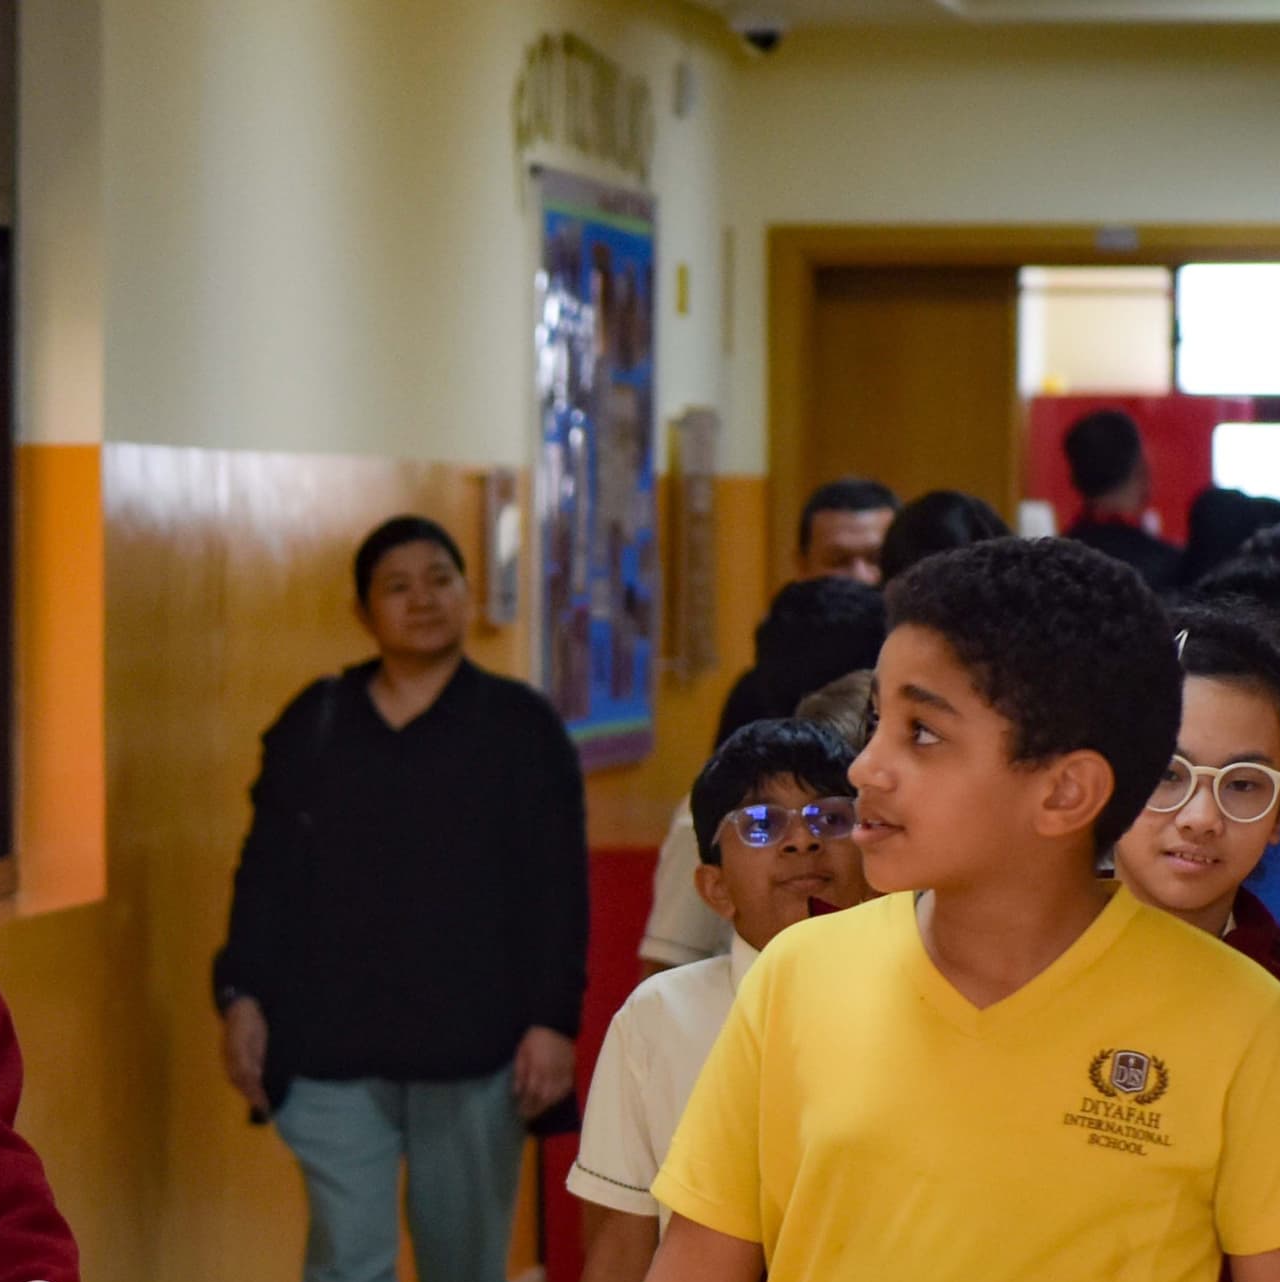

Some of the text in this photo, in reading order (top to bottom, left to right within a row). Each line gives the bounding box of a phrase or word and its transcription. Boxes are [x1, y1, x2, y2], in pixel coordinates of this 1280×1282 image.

[1080, 1097, 1161, 1129] DIYAFAH
[1063, 1113, 1172, 1146] INTERNATIONAL
[1088, 1133, 1147, 1156] SCHOOL
